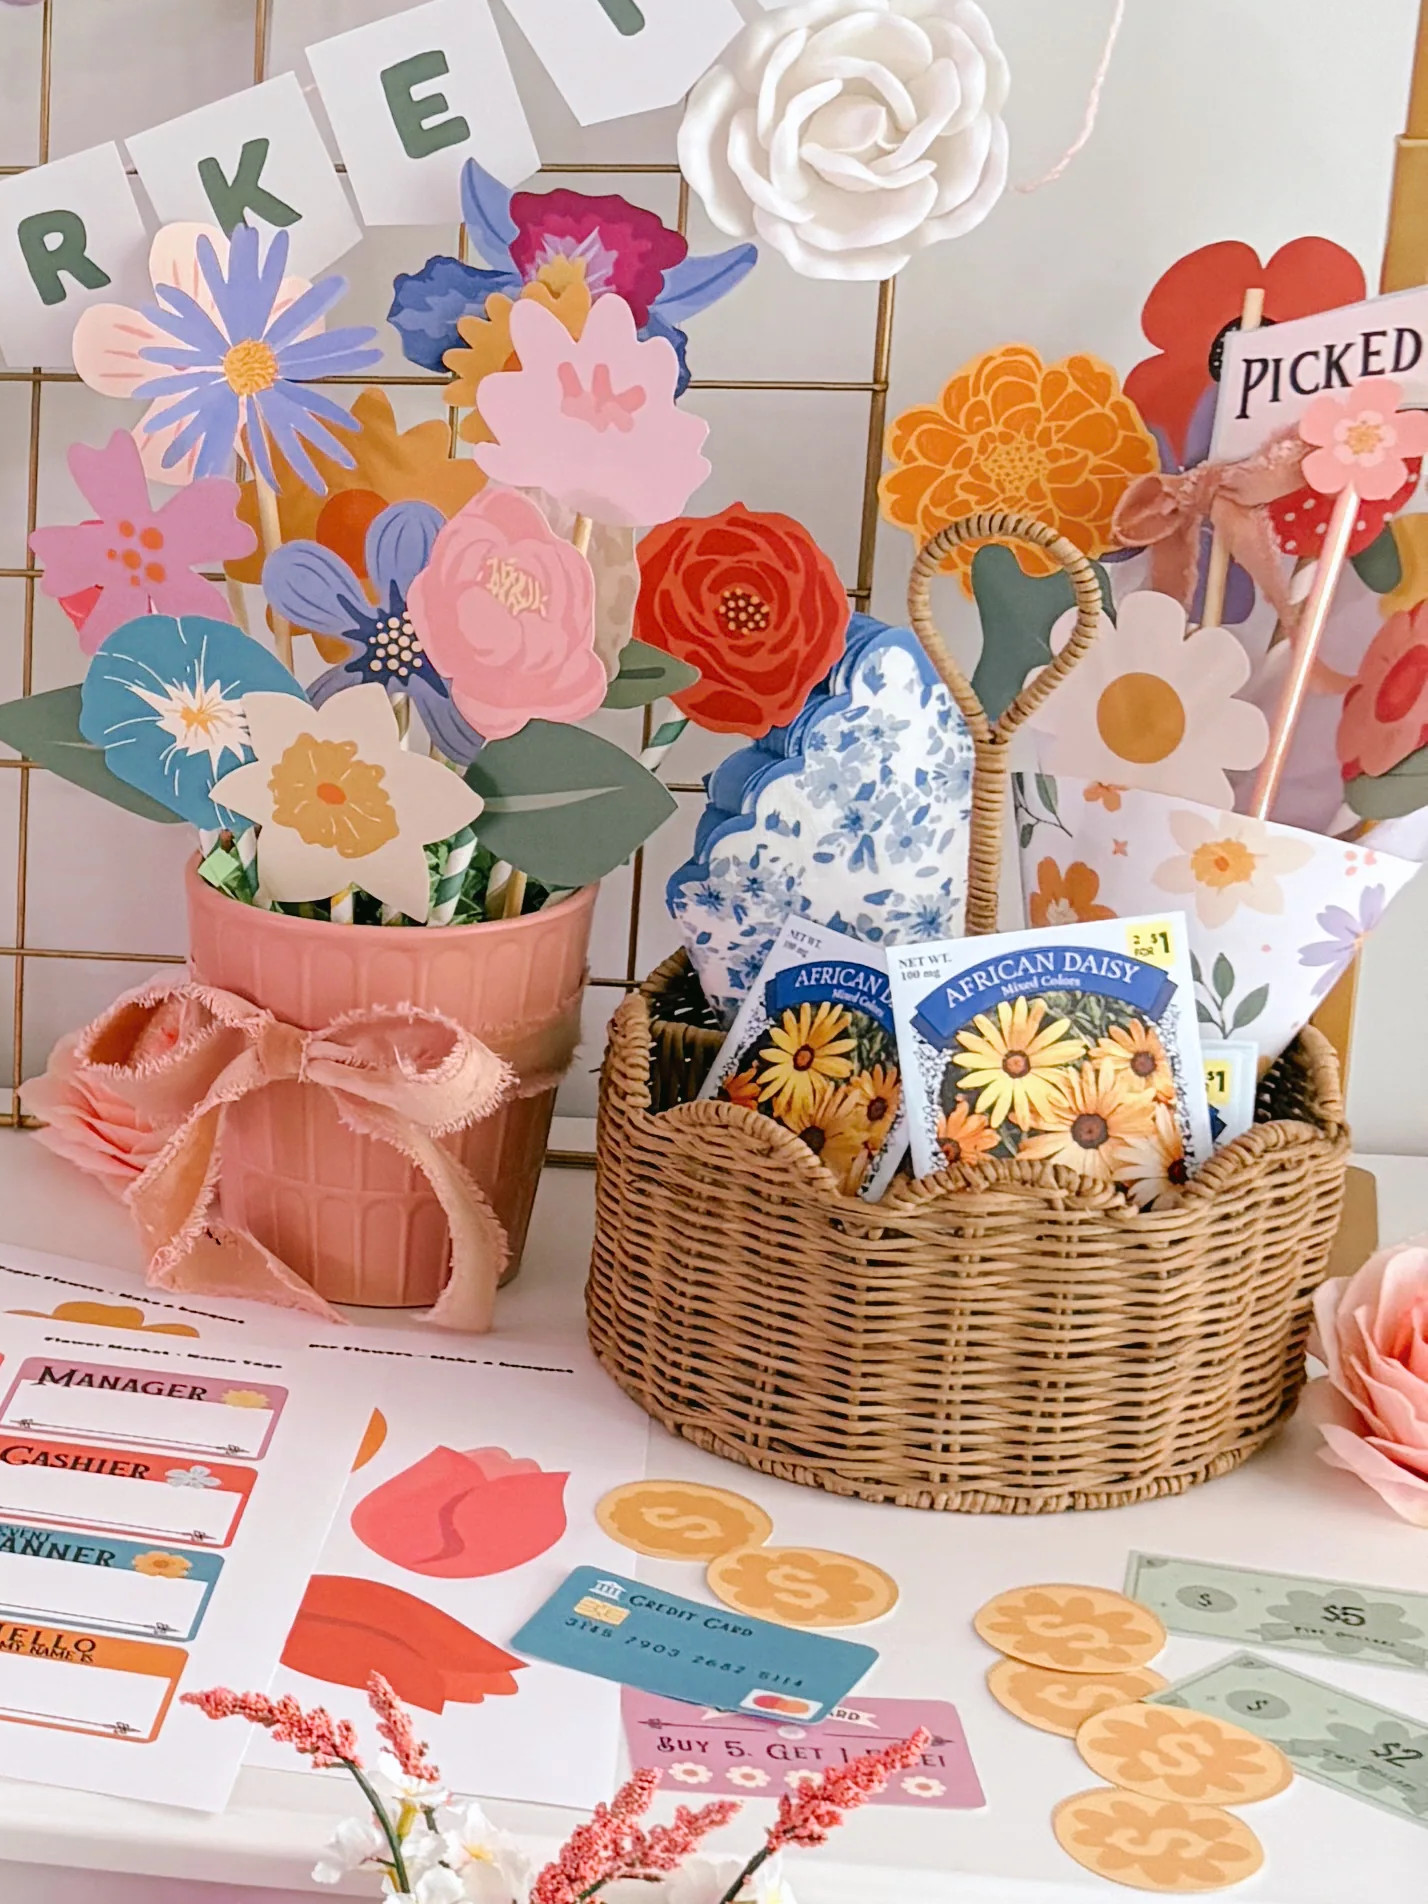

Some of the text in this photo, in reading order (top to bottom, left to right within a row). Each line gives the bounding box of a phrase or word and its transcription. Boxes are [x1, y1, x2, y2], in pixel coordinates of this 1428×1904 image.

[1235, 328, 1423, 420] PICKED
[898, 956, 925, 969] NET
[795, 966, 883, 993] AFRICAN
[946, 951, 1056, 1009] AFRICAN
[1064, 951, 1141, 985] DAISY
[1001, 973, 1082, 998] Mixed Colors
[831, 987, 861, 1005] Mixed
[30, 1365, 208, 1402] MANAGER
[0, 1445, 151, 1480] CASHIER
[629, 1595, 753, 1637] CREDIT CARD
[1321, 1604, 1366, 1626] $5
[29, 1642, 78, 1659] NAME
[657, 1736, 710, 1753] BUY
[766, 1743, 823, 1761] GET
[1370, 1742, 1424, 1768] $2
